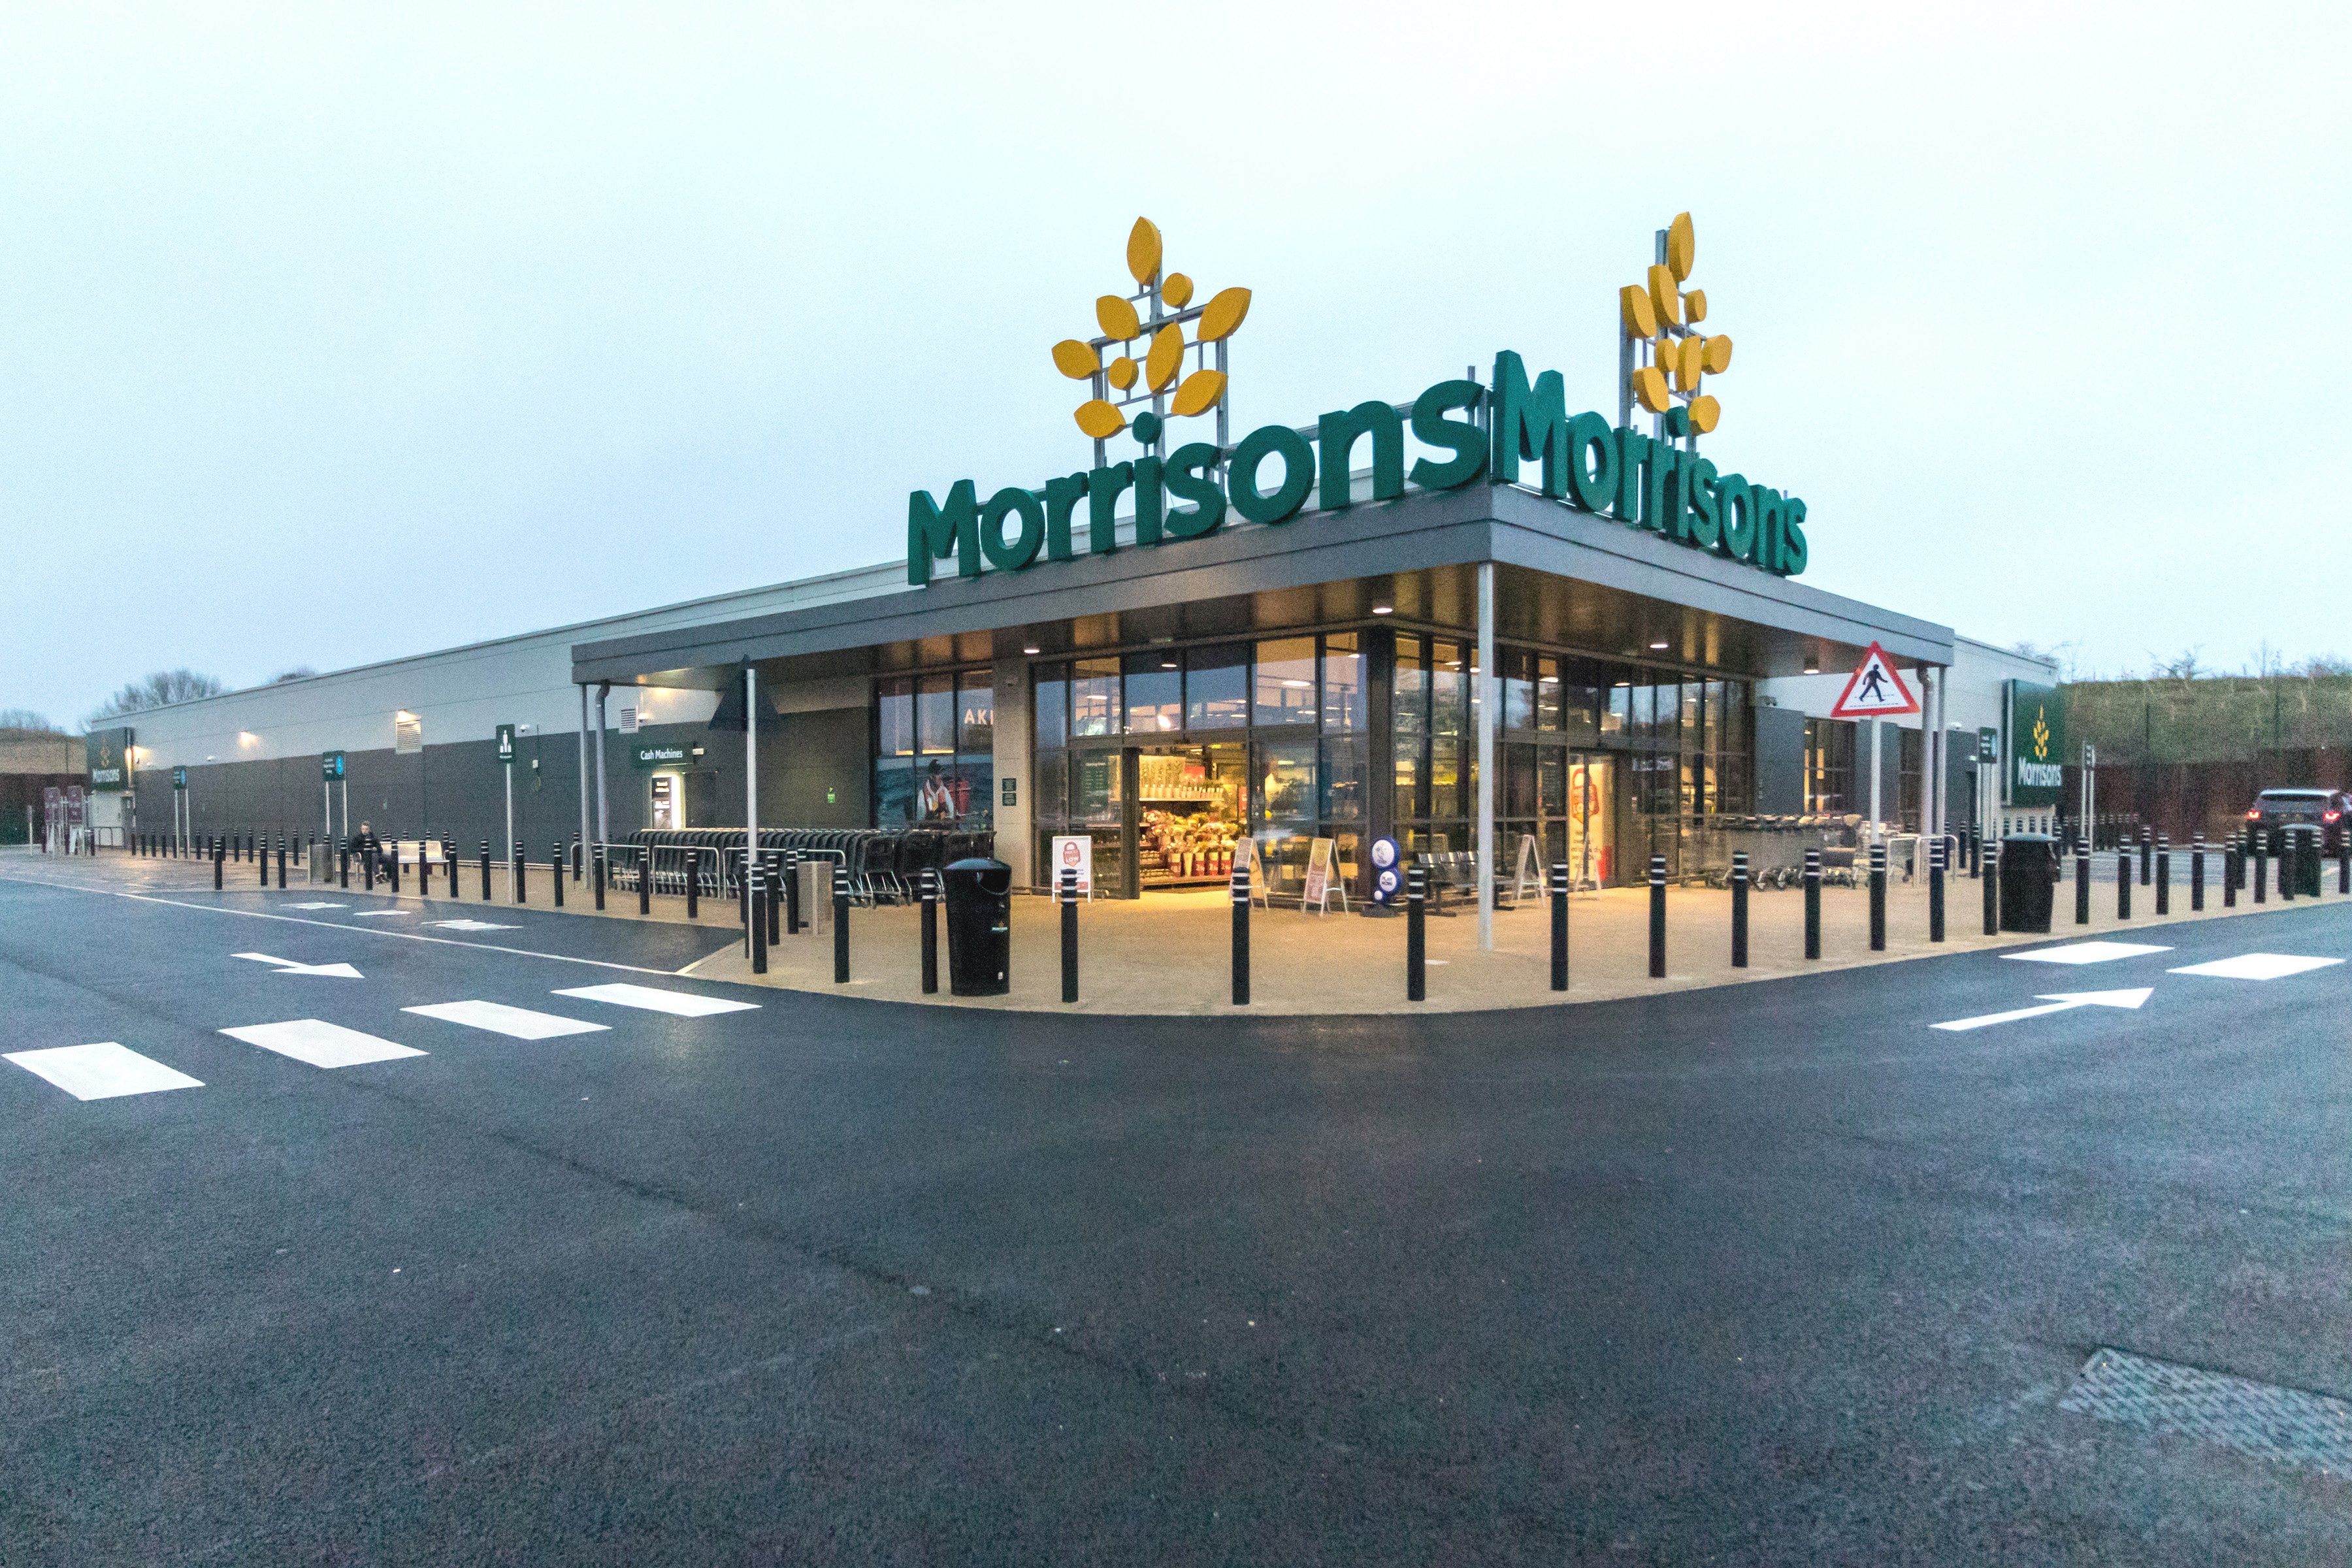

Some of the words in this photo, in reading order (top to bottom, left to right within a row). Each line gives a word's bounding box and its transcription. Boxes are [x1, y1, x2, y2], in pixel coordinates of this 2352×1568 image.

[907, 380, 1492, 586] Morrisons
[1490, 350, 1808, 576] Morrisons
[640, 749, 654, 760] Cash
[655, 748, 683, 759] Machines
[2018, 757, 2062, 787] Morrisons
